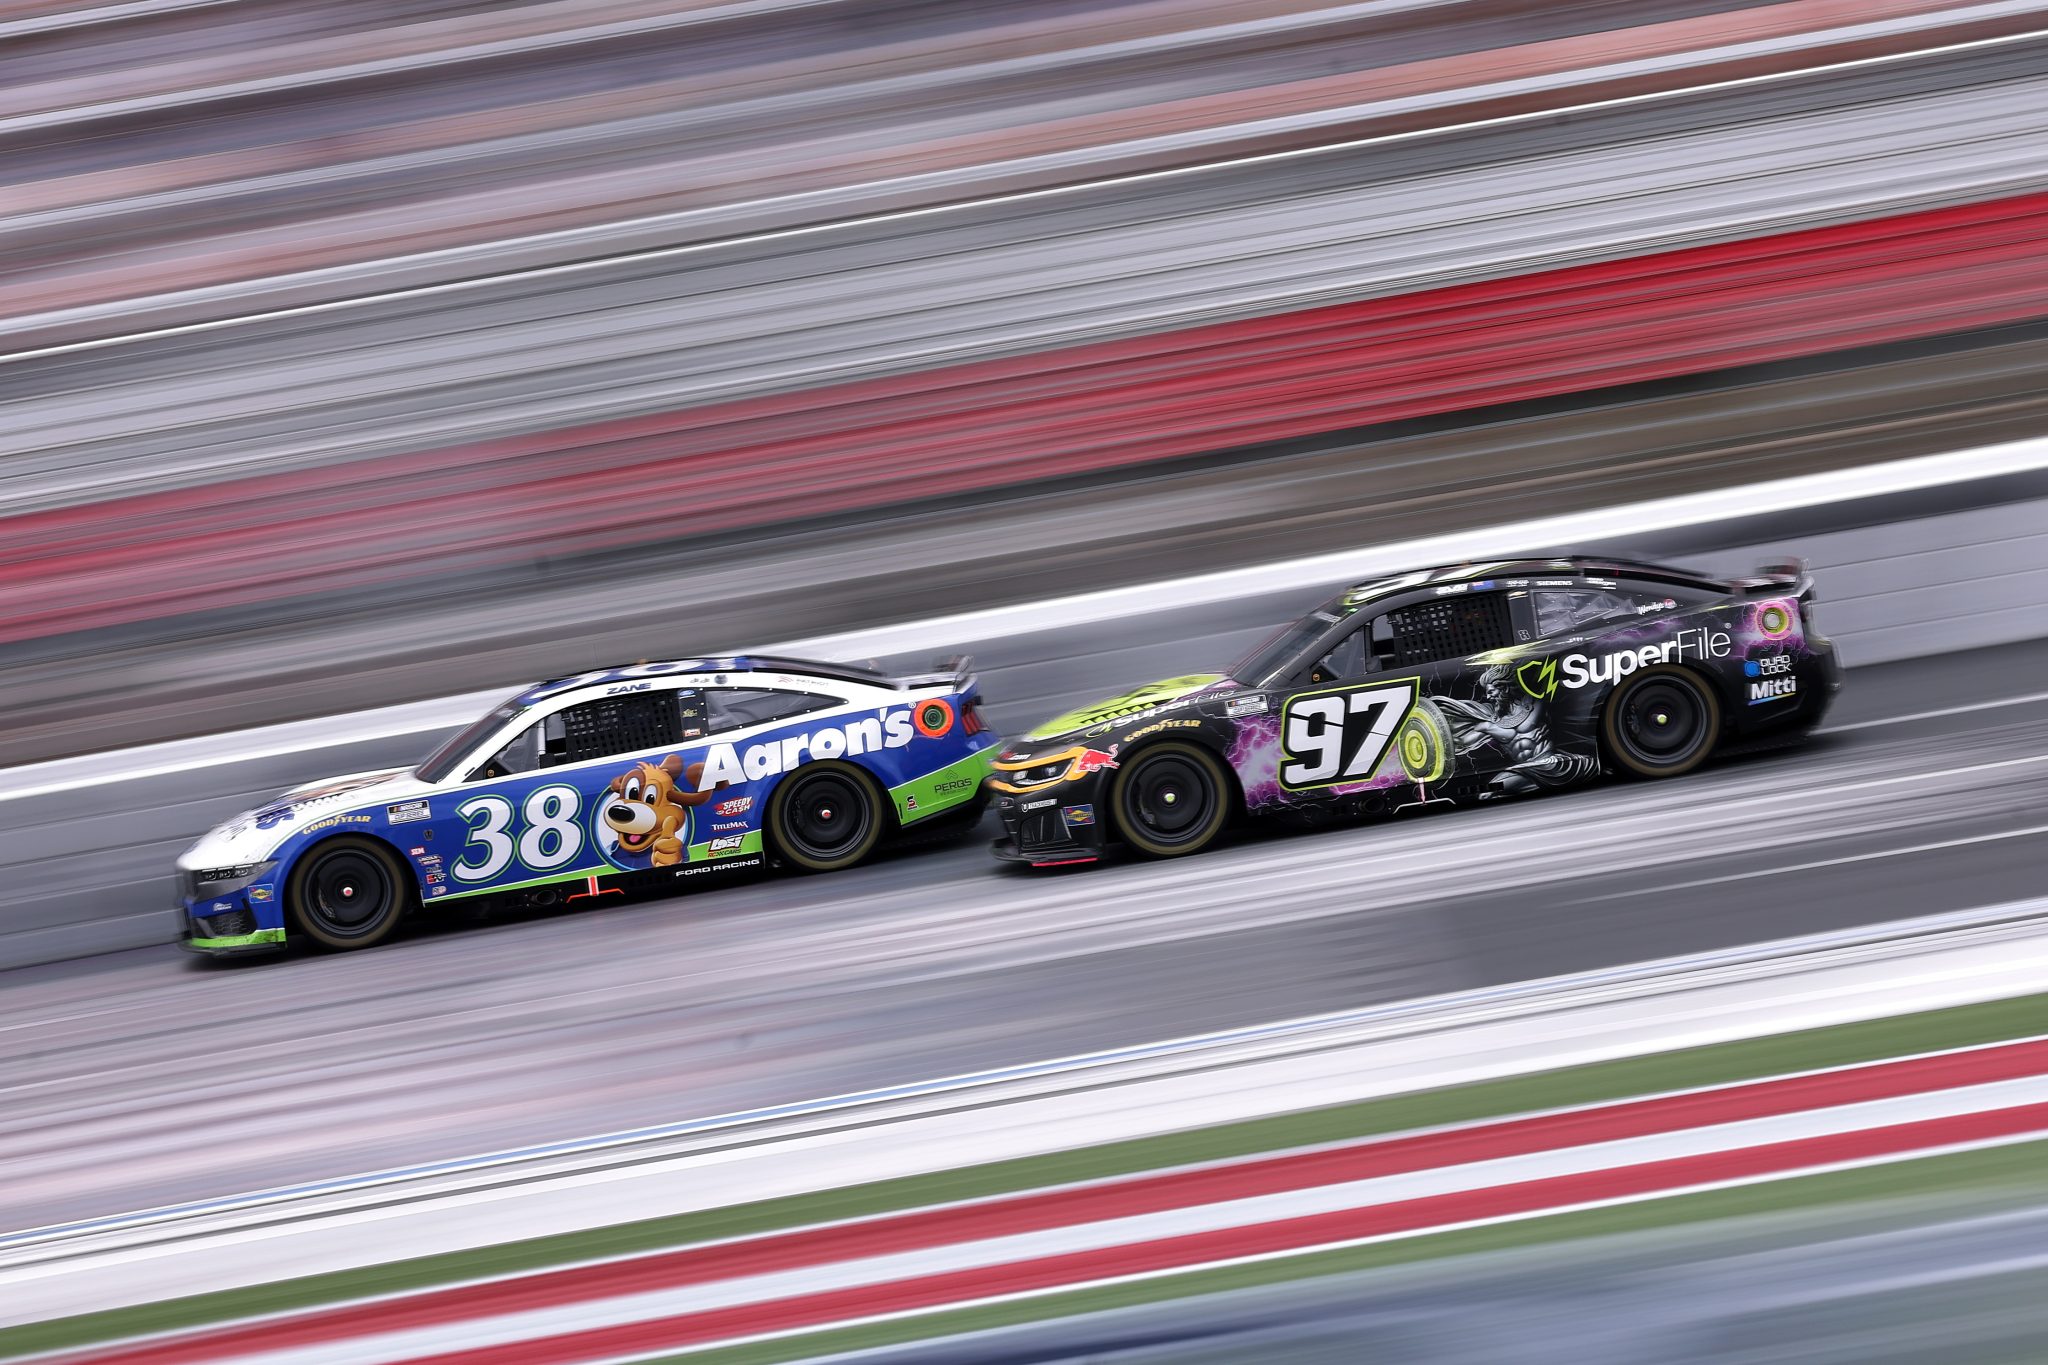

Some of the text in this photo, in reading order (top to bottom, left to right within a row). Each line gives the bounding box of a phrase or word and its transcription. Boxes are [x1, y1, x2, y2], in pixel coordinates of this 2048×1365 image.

[1562, 626, 1733, 689] SuperFile
[1760, 654, 1790, 668] QUAD
[1761, 663, 1792, 676] LOCK
[607, 683, 652, 695] ZANE
[1751, 676, 1797, 700] Mitti
[1123, 718, 1201, 742] GOODYEAR
[1284, 685, 1411, 785] 97
[697, 706, 915, 793] Aaron's
[723, 796, 753, 810] SPEEDY
[725, 804, 751, 815] CASH
[302, 813, 371, 835] GOODYEAR
[454, 786, 579, 882] 38
[675, 858, 760, 877] FORD RACING
